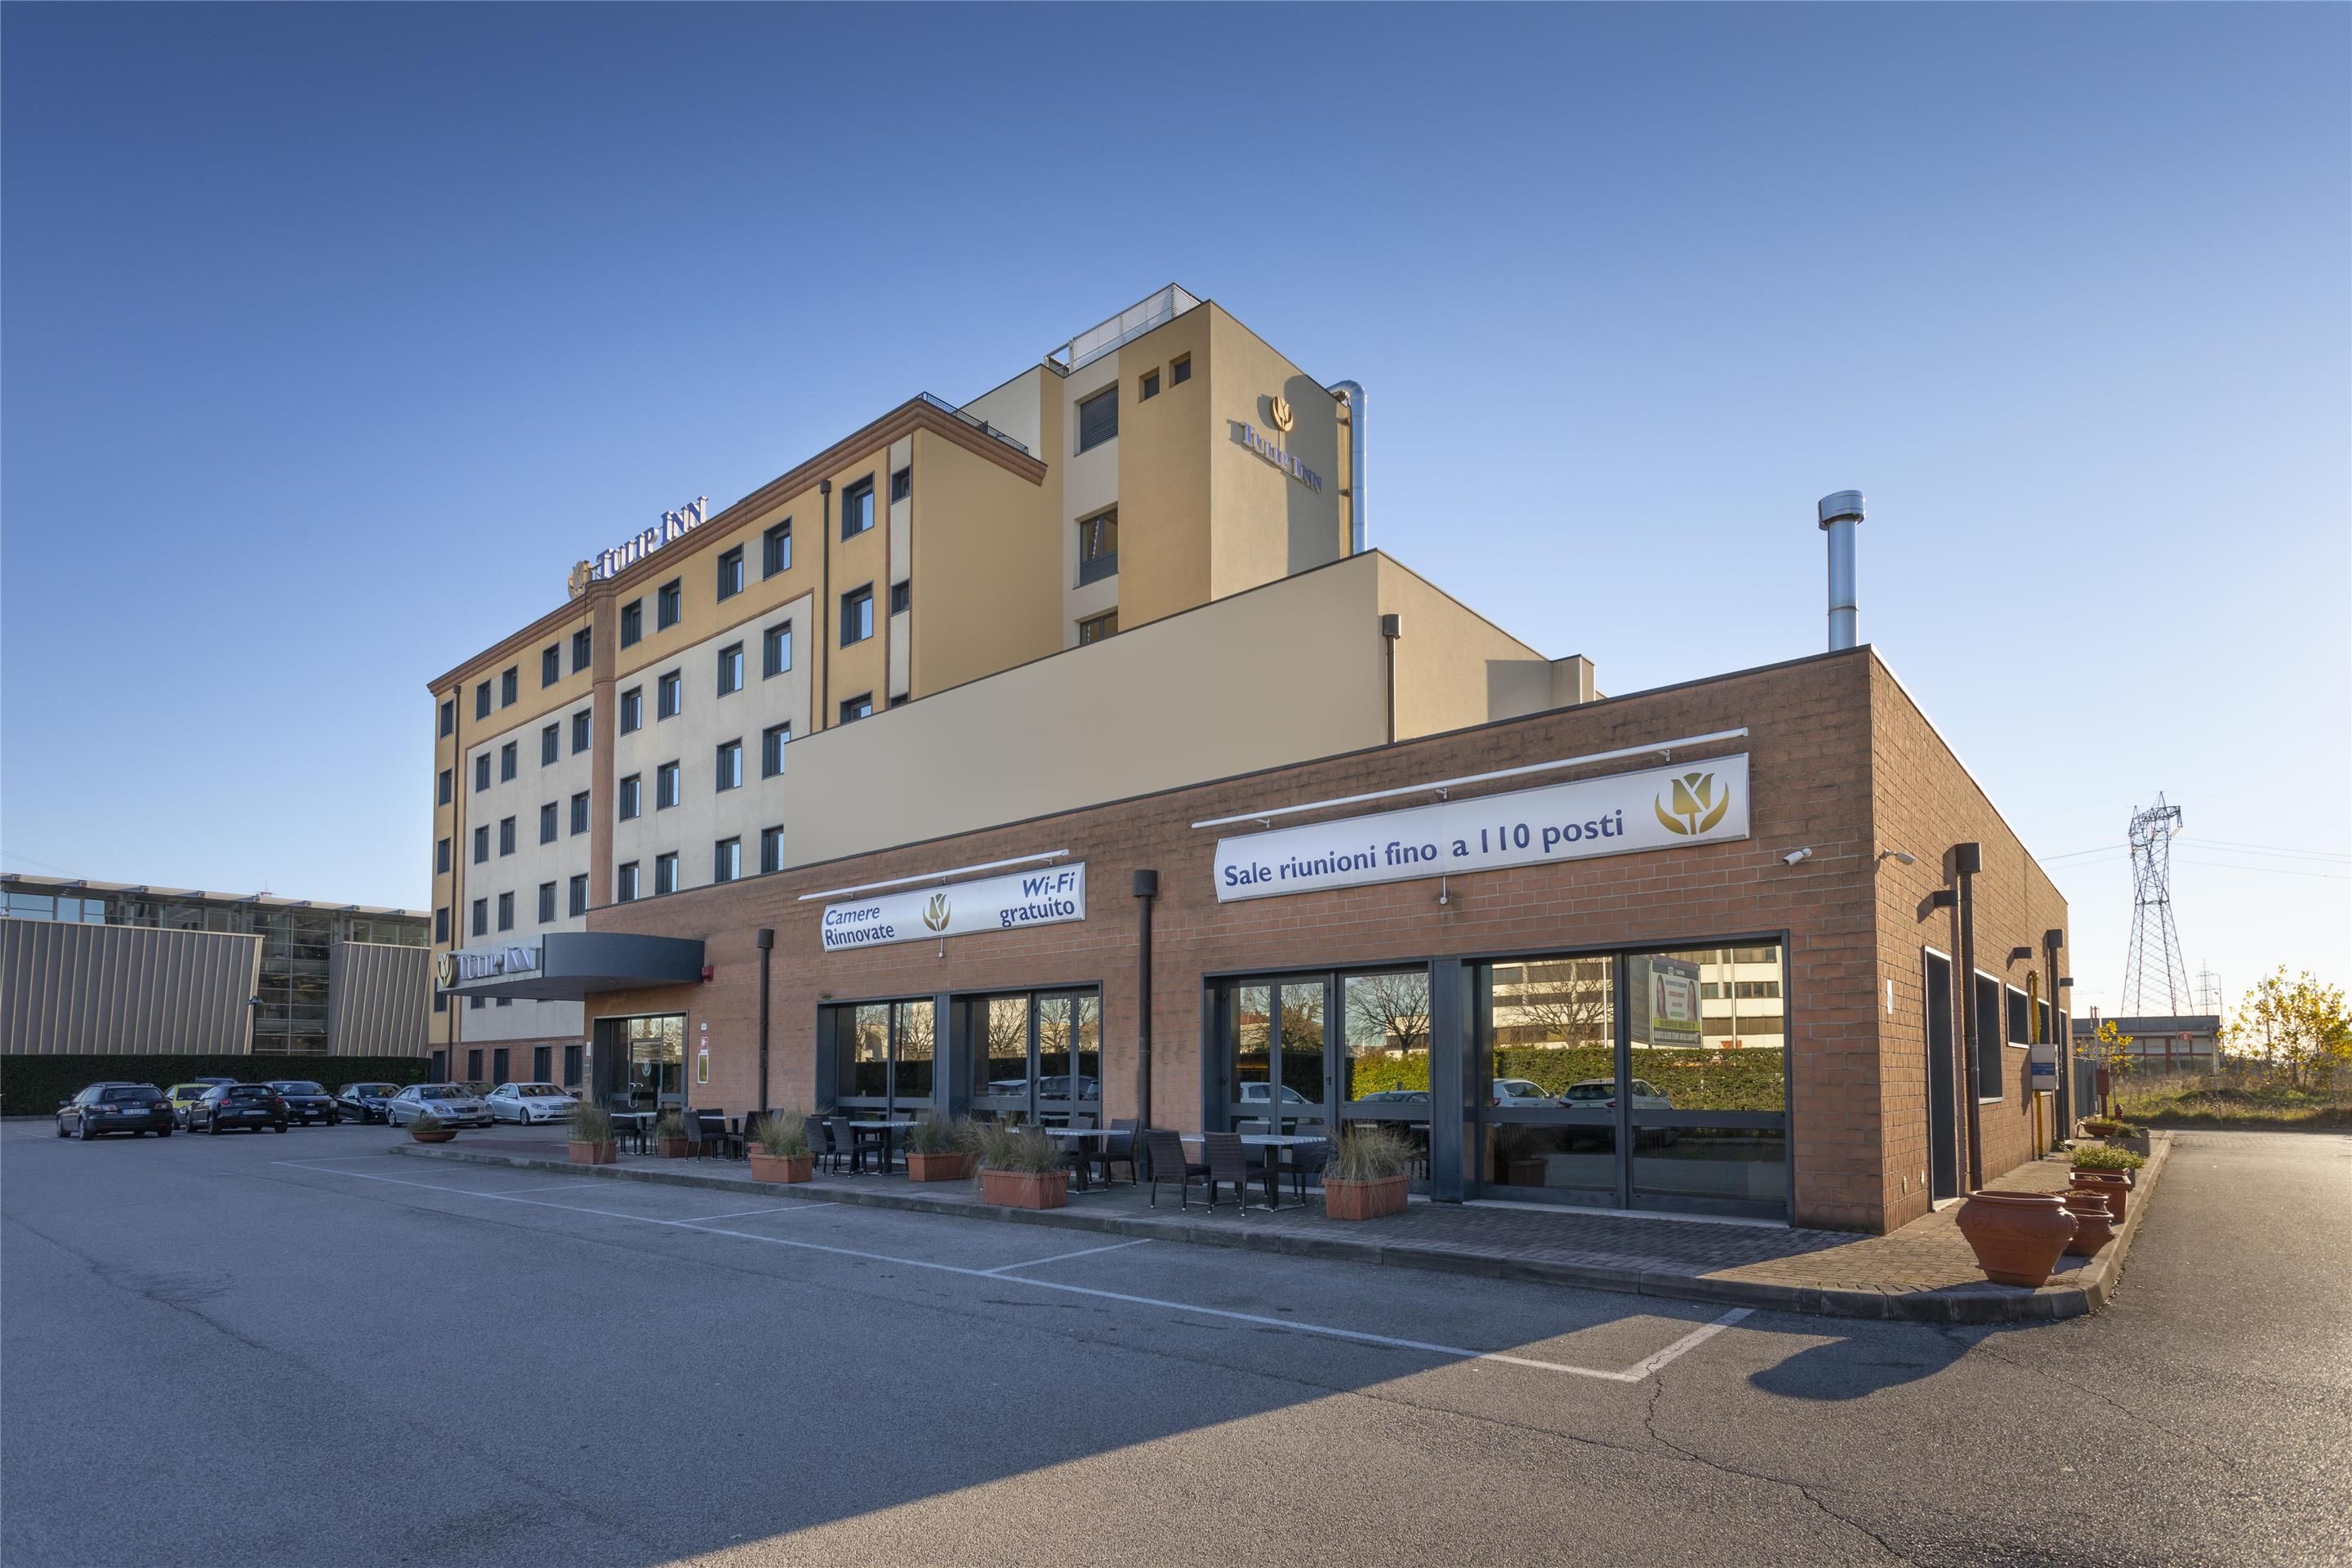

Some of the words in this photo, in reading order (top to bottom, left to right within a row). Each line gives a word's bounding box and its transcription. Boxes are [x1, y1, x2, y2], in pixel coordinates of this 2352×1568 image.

[1241, 419, 1290, 471] TULIP
[1291, 456, 1322, 494] INN
[596, 527, 659, 578] TULIP
[661, 496, 708, 546] INN
[1224, 862, 1272, 886] Sale
[1280, 844, 1376, 880] riunioni
[1384, 841, 1437, 866] fino
[1452, 839, 1469, 858] a
[1481, 822, 1530, 853] 110
[1542, 809, 1624, 853] posti
[1022, 871, 1076, 898] Wi-Fi
[825, 906, 880, 926] Camere
[1000, 897, 1076, 928] gratuito
[825, 923, 895, 947] Rinnovate
[457, 953, 505, 980] TULIP
[504, 947, 540, 973] INN
